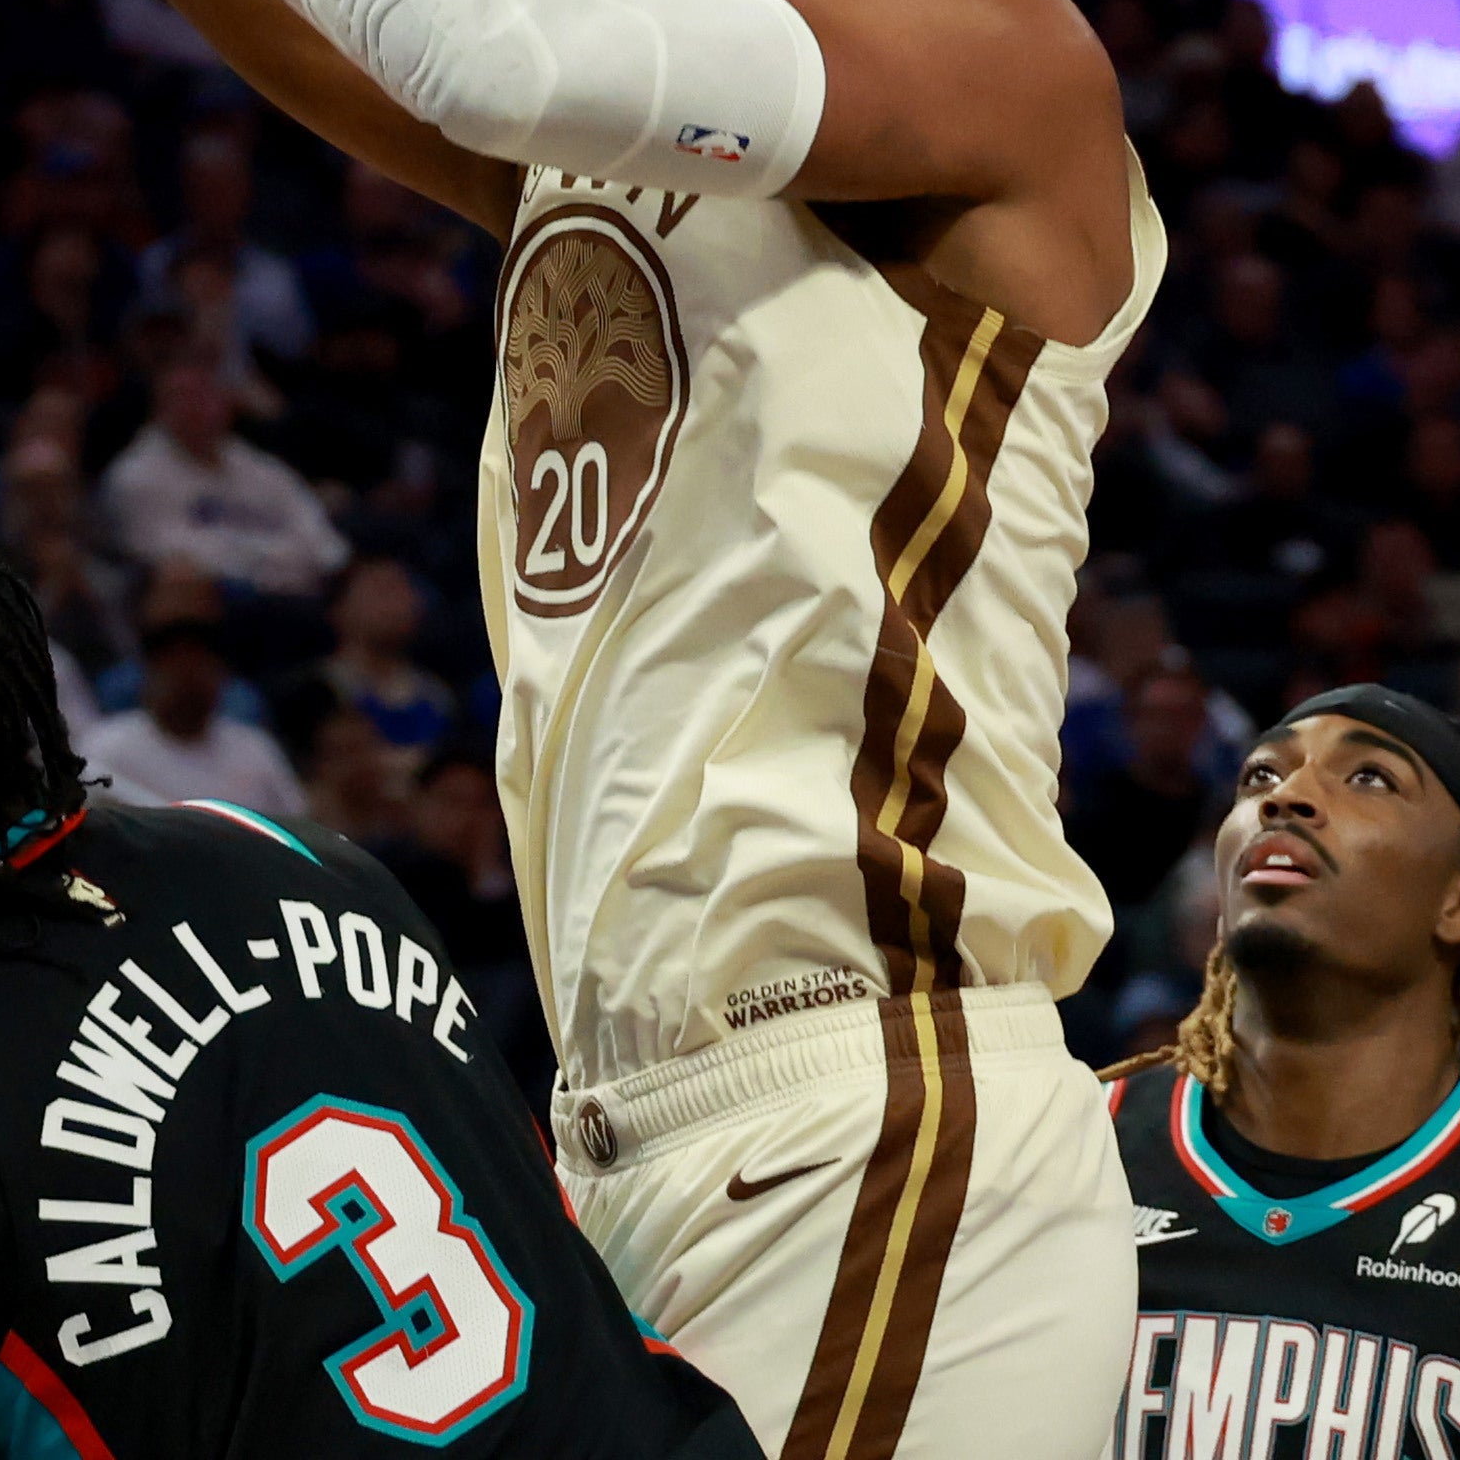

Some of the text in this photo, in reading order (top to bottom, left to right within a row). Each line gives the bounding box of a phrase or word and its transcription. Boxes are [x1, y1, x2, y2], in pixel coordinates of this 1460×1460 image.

[523, 440, 609, 575] 20
[722, 978, 868, 1030] WARRIORS
[726, 978, 797, 1008] GOLDEN
[38, 898, 478, 1367] CALDWELL-POPE
[241, 1092, 536, 1448] 3
